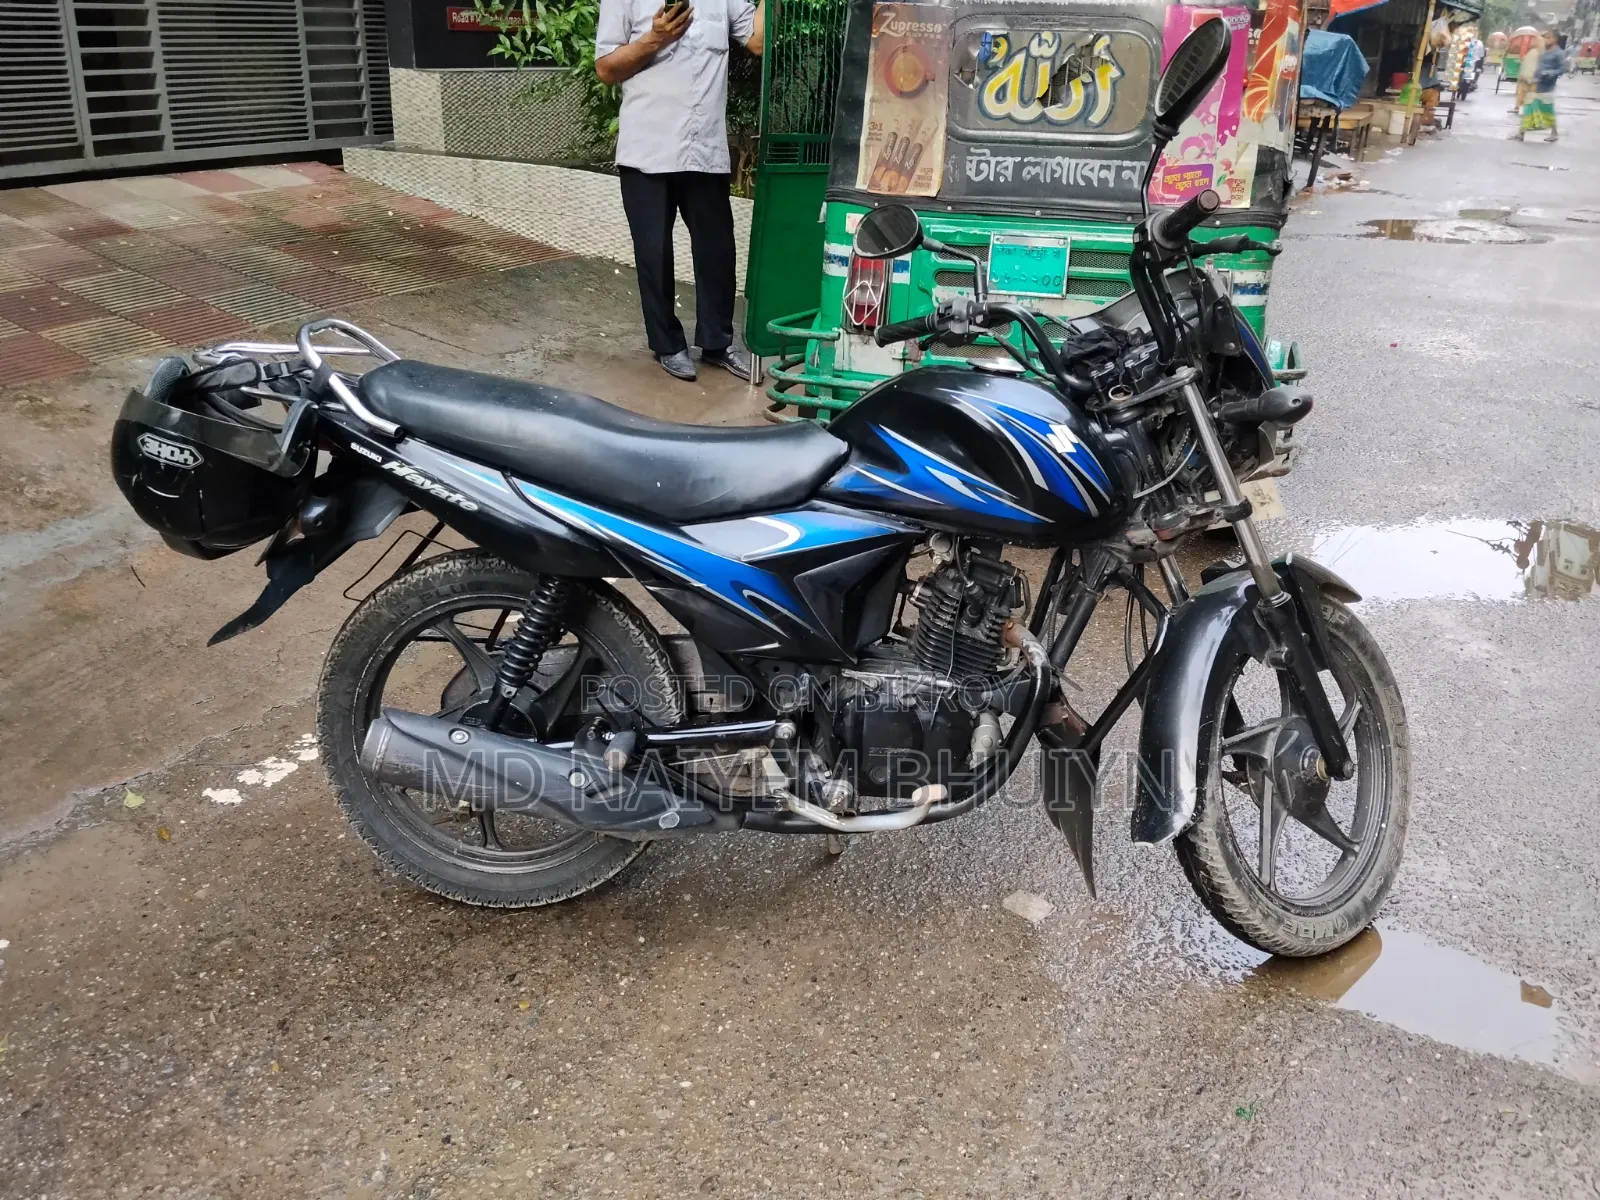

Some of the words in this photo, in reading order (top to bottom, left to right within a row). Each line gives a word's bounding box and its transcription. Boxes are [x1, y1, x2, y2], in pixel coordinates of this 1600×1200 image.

[880, 12, 943, 37] Zupresso
[143, 437, 195, 465] YOHE
[350, 442, 382, 463] SUZUKI
[381, 460, 479, 511] Hayate
